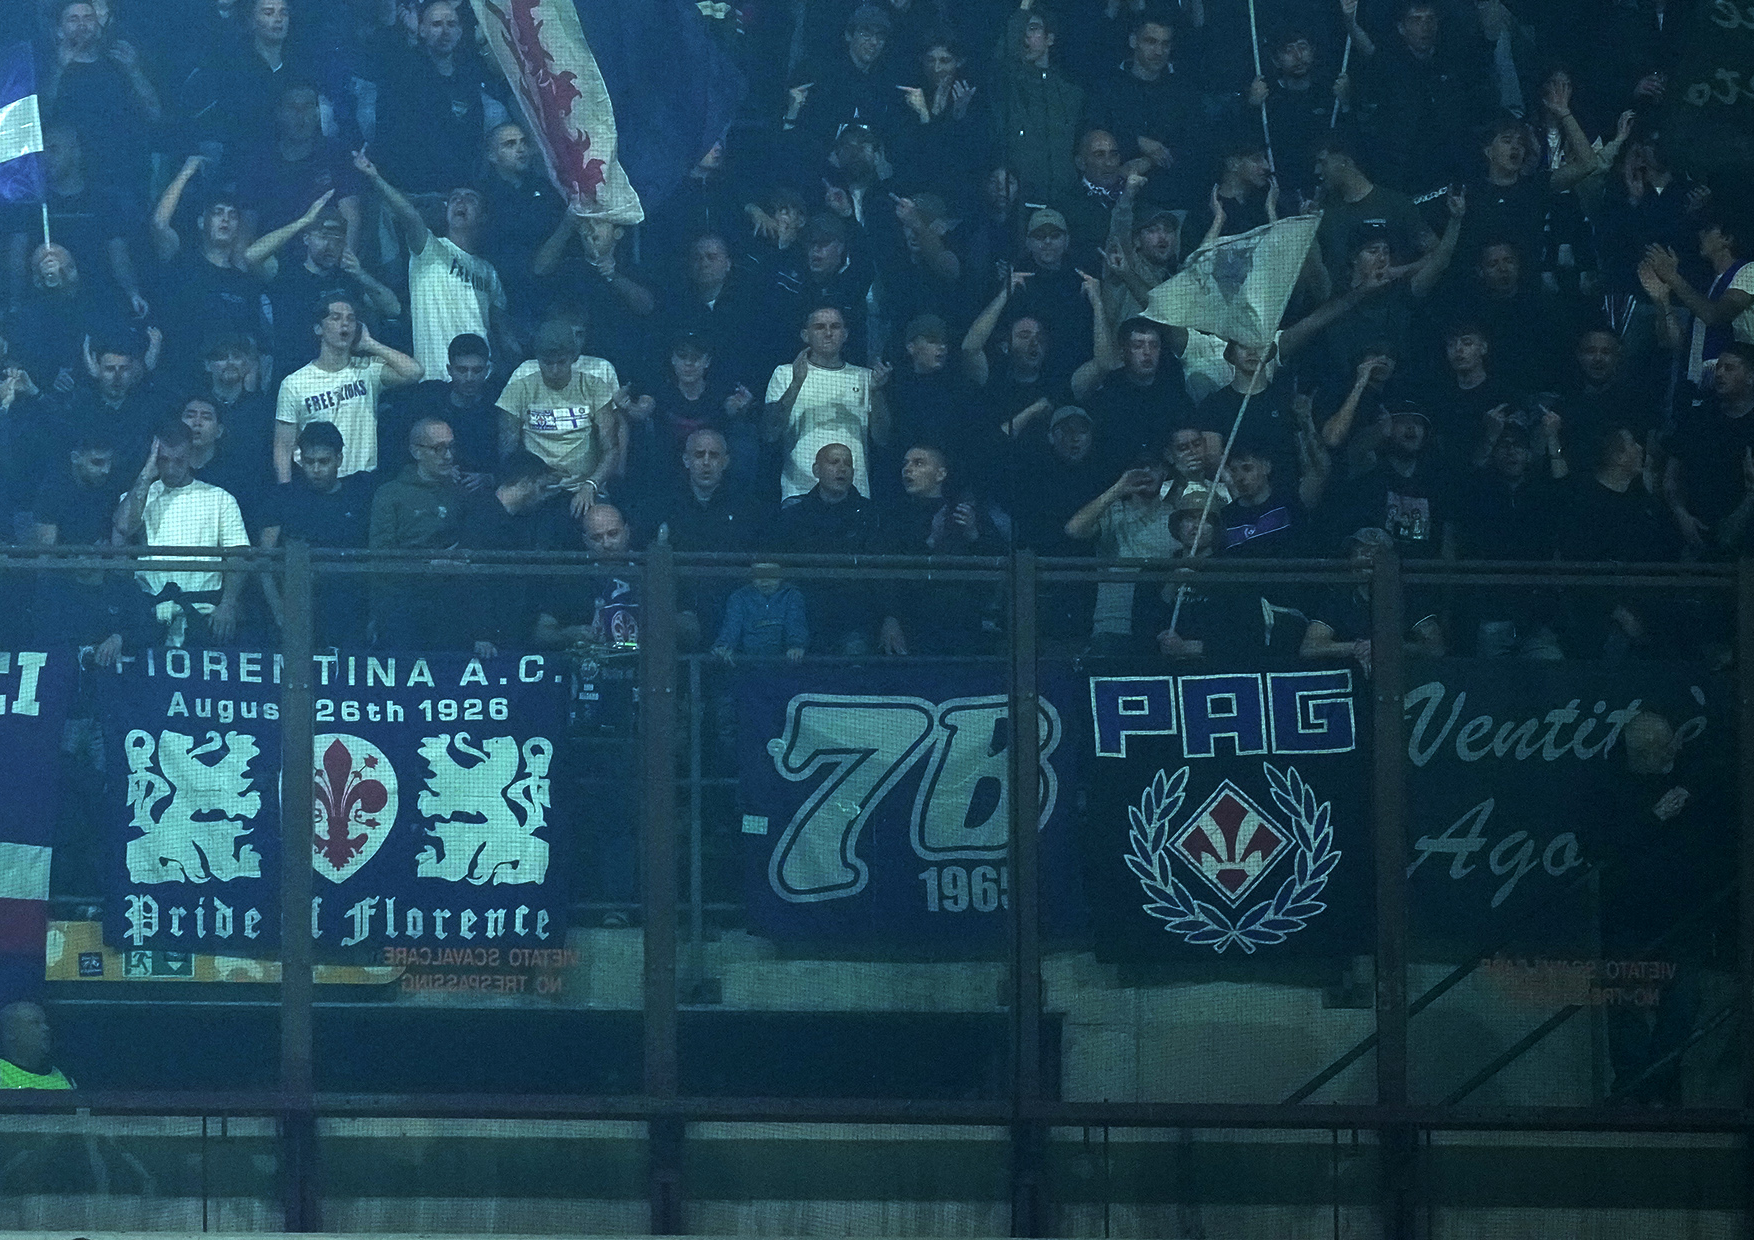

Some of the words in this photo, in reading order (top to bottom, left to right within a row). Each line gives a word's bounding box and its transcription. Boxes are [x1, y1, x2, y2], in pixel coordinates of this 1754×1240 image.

[305, 391, 335, 415] FREE
[459, 653, 563, 687] A.C.
[167, 690, 280, 724] Augus
[315, 698, 404, 722] 26th
[418, 697, 509, 721] 1926
[1089, 669, 1356, 758] PAG
[1404, 680, 1708, 767] Ventitè
[123, 893, 262, 946] Pride
[340, 894, 550, 947] Florence
